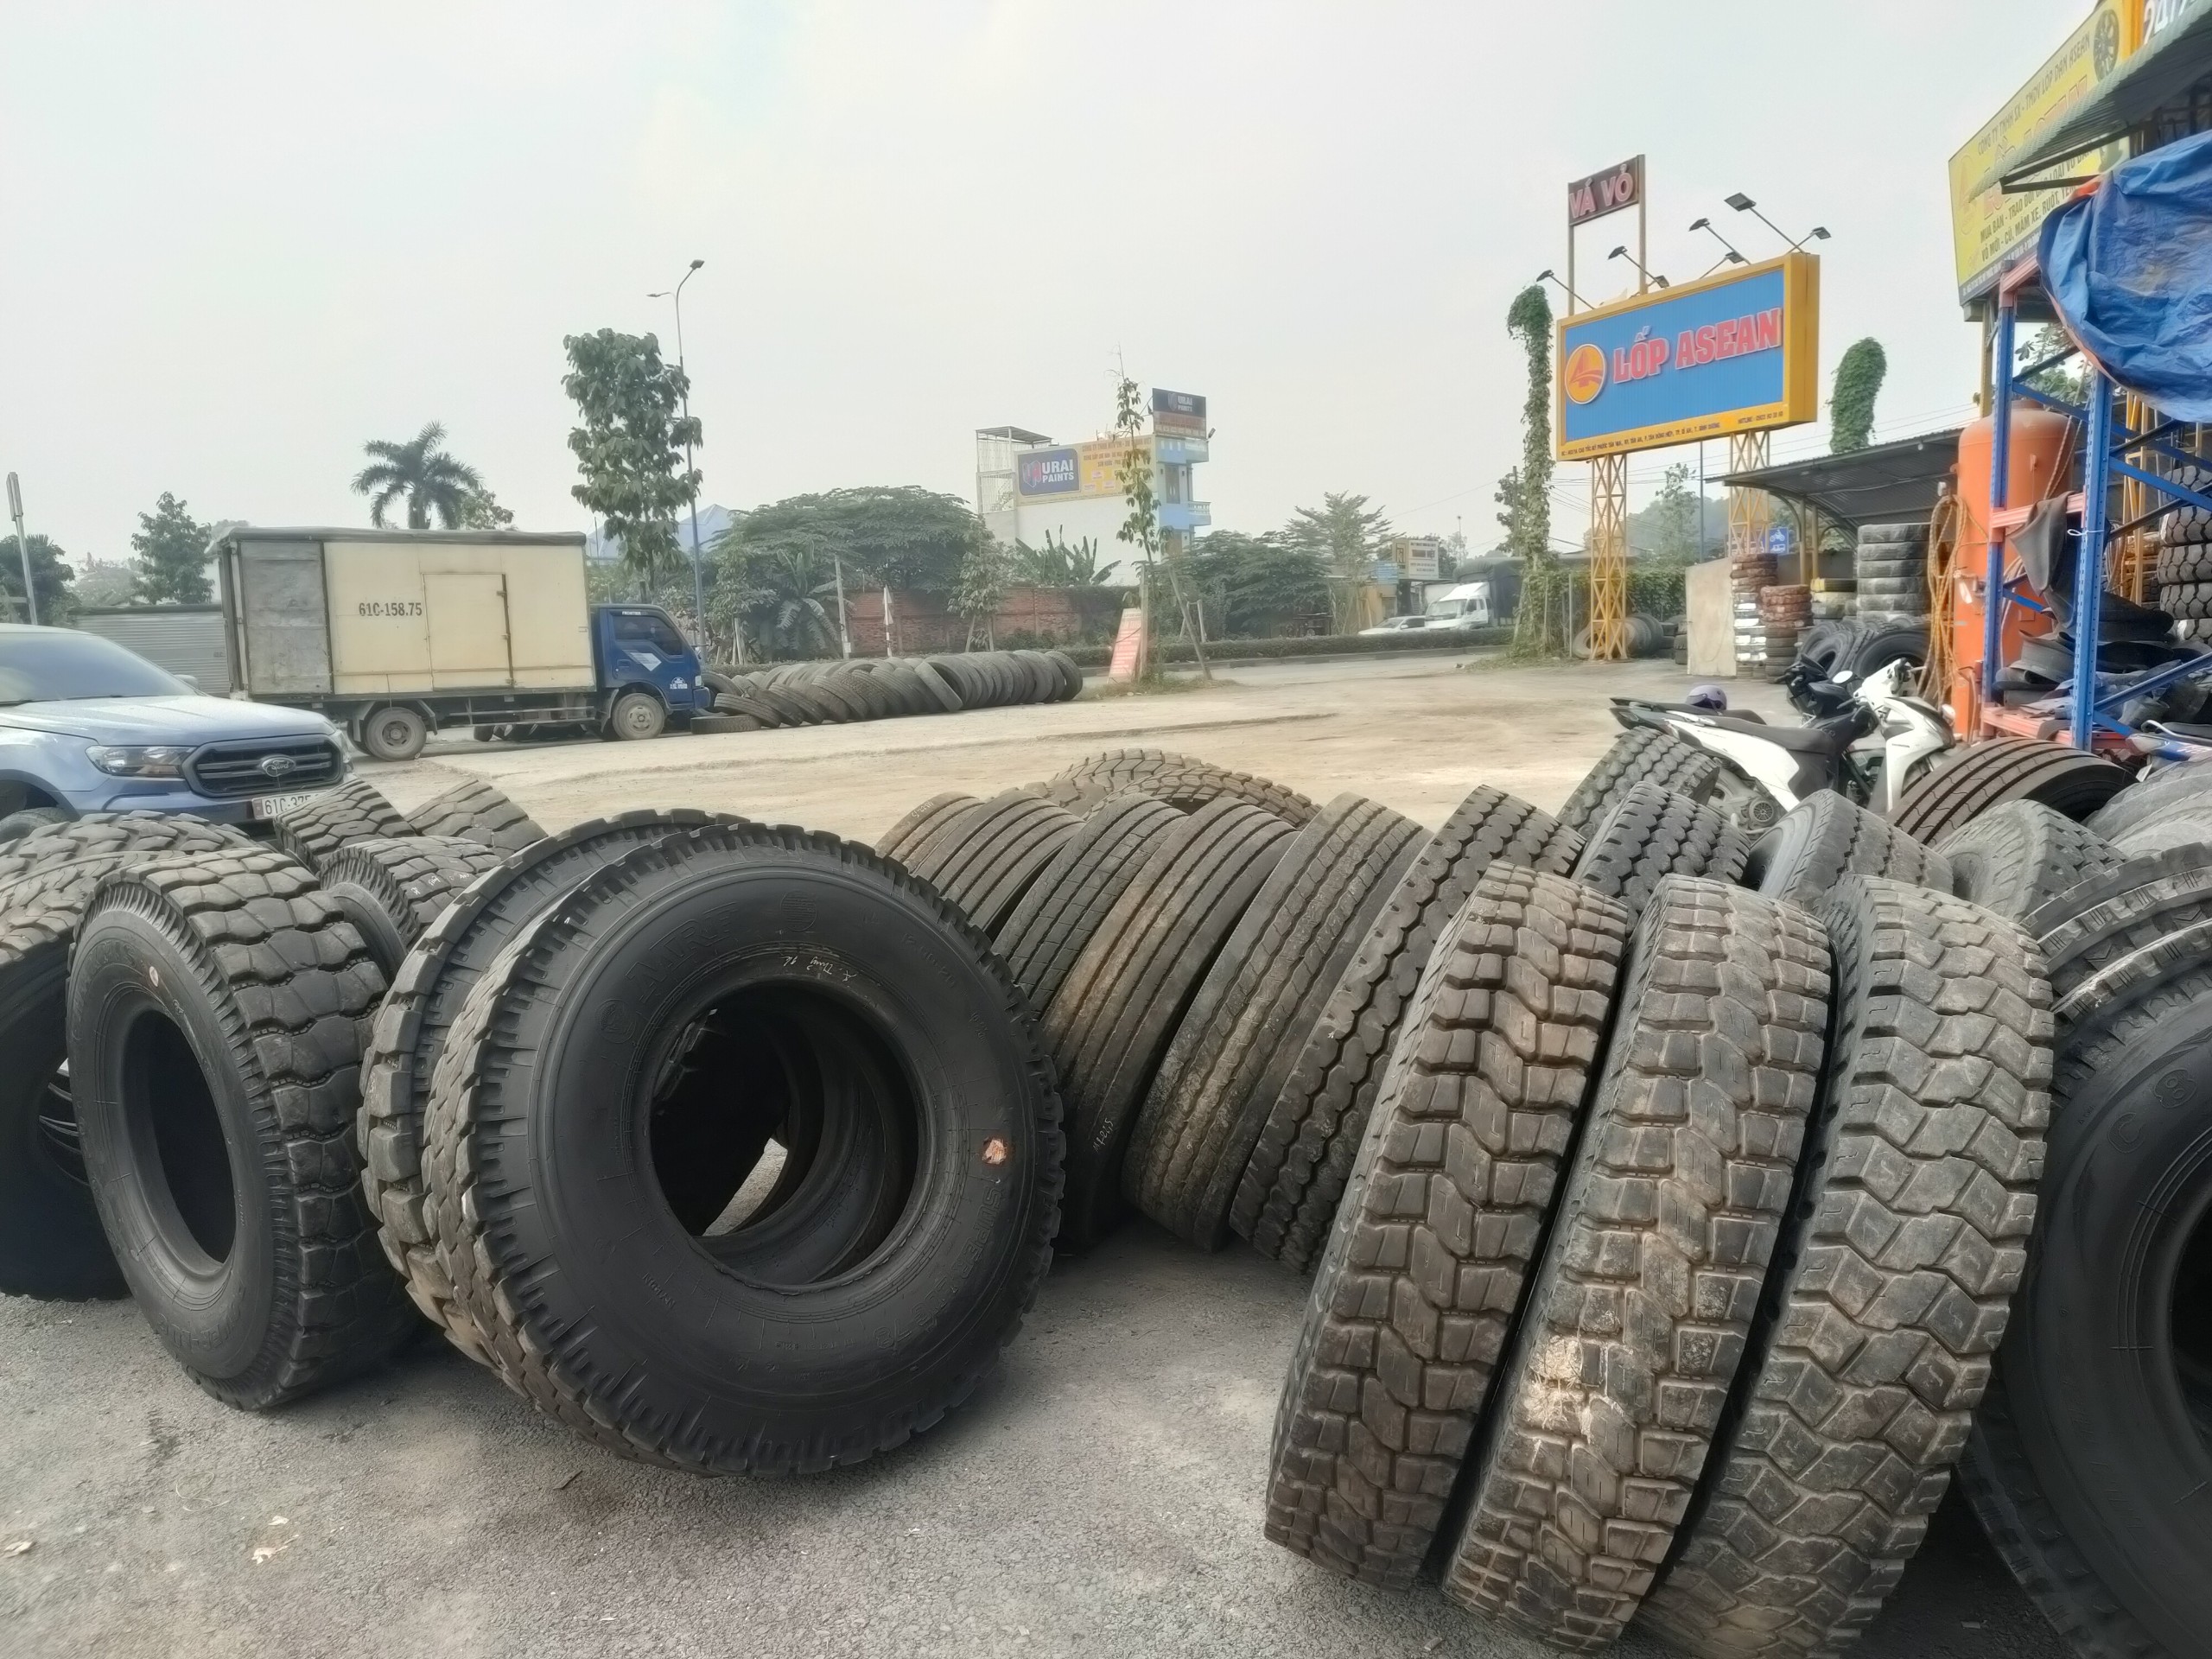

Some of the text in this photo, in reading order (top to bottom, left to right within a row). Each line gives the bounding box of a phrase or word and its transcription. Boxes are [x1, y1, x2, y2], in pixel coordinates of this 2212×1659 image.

[1568, 163, 1635, 219] VÁ VỎ
[1612, 307, 1783, 384] LỐP ASEAN
[1042, 459, 1073, 474] URAI
[1042, 470, 1074, 484] PAINTS
[359, 602, 423, 616] 61C-158.75
[951, 1186, 1002, 1279] SUPER
